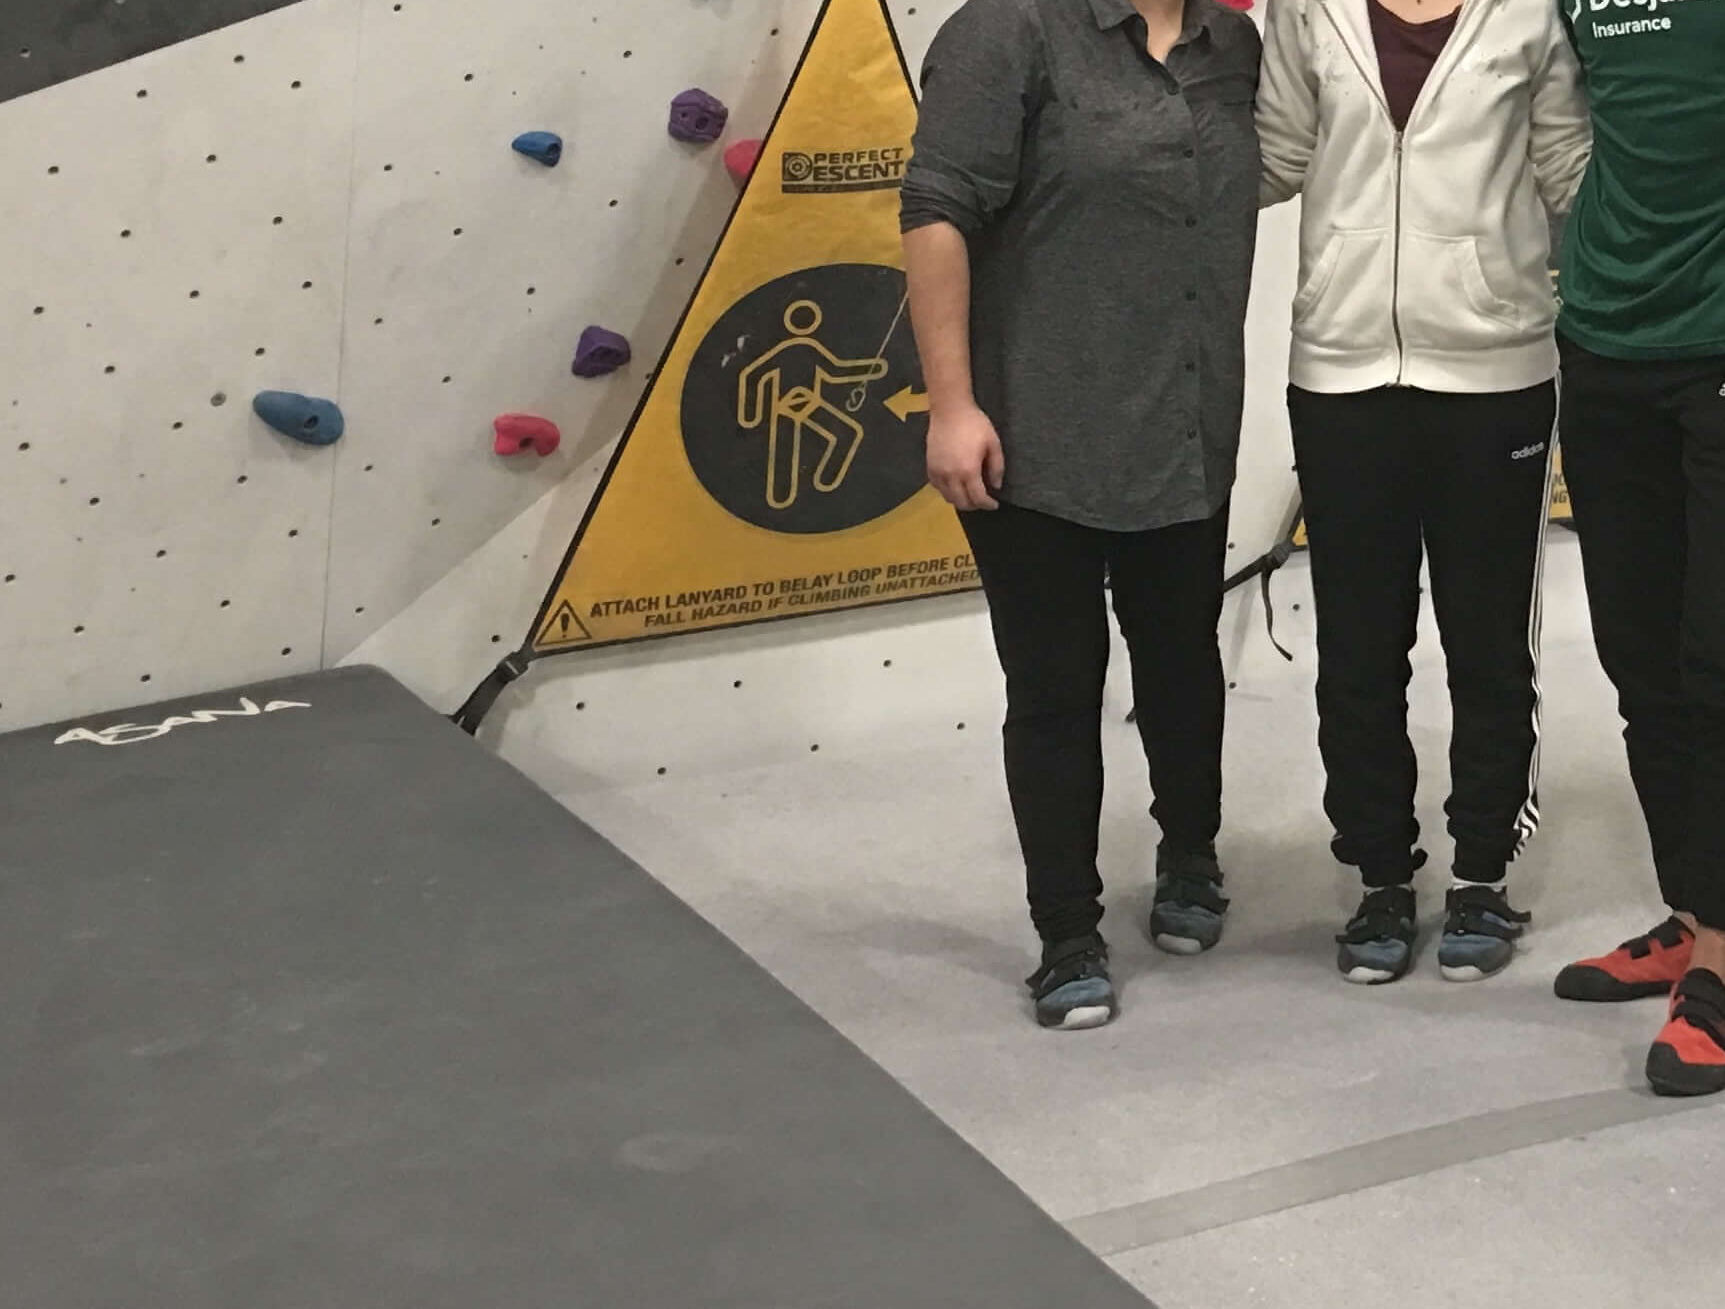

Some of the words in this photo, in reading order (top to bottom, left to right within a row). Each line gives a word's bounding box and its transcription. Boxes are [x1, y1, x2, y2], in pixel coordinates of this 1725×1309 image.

[1592, 16, 1672, 38] Insurance
[813, 148, 904, 165] PERFECT
[1511, 441, 1545, 460] adidas
[590, 596, 660, 619] ATTACH
[665, 585, 748, 609] LANYARD
[753, 581, 774, 596] TO
[780, 572, 834, 593] BELAY
[838, 567, 882, 585] LOOP
[886, 557, 950, 579] BEFORE
[643, 611, 687, 628] FALL
[691, 599, 763, 621] HAZARD
[767, 596, 785, 611] IF
[787, 585, 871, 606] CLIMBING
[875, 569, 980, 593] UNATTACHED
